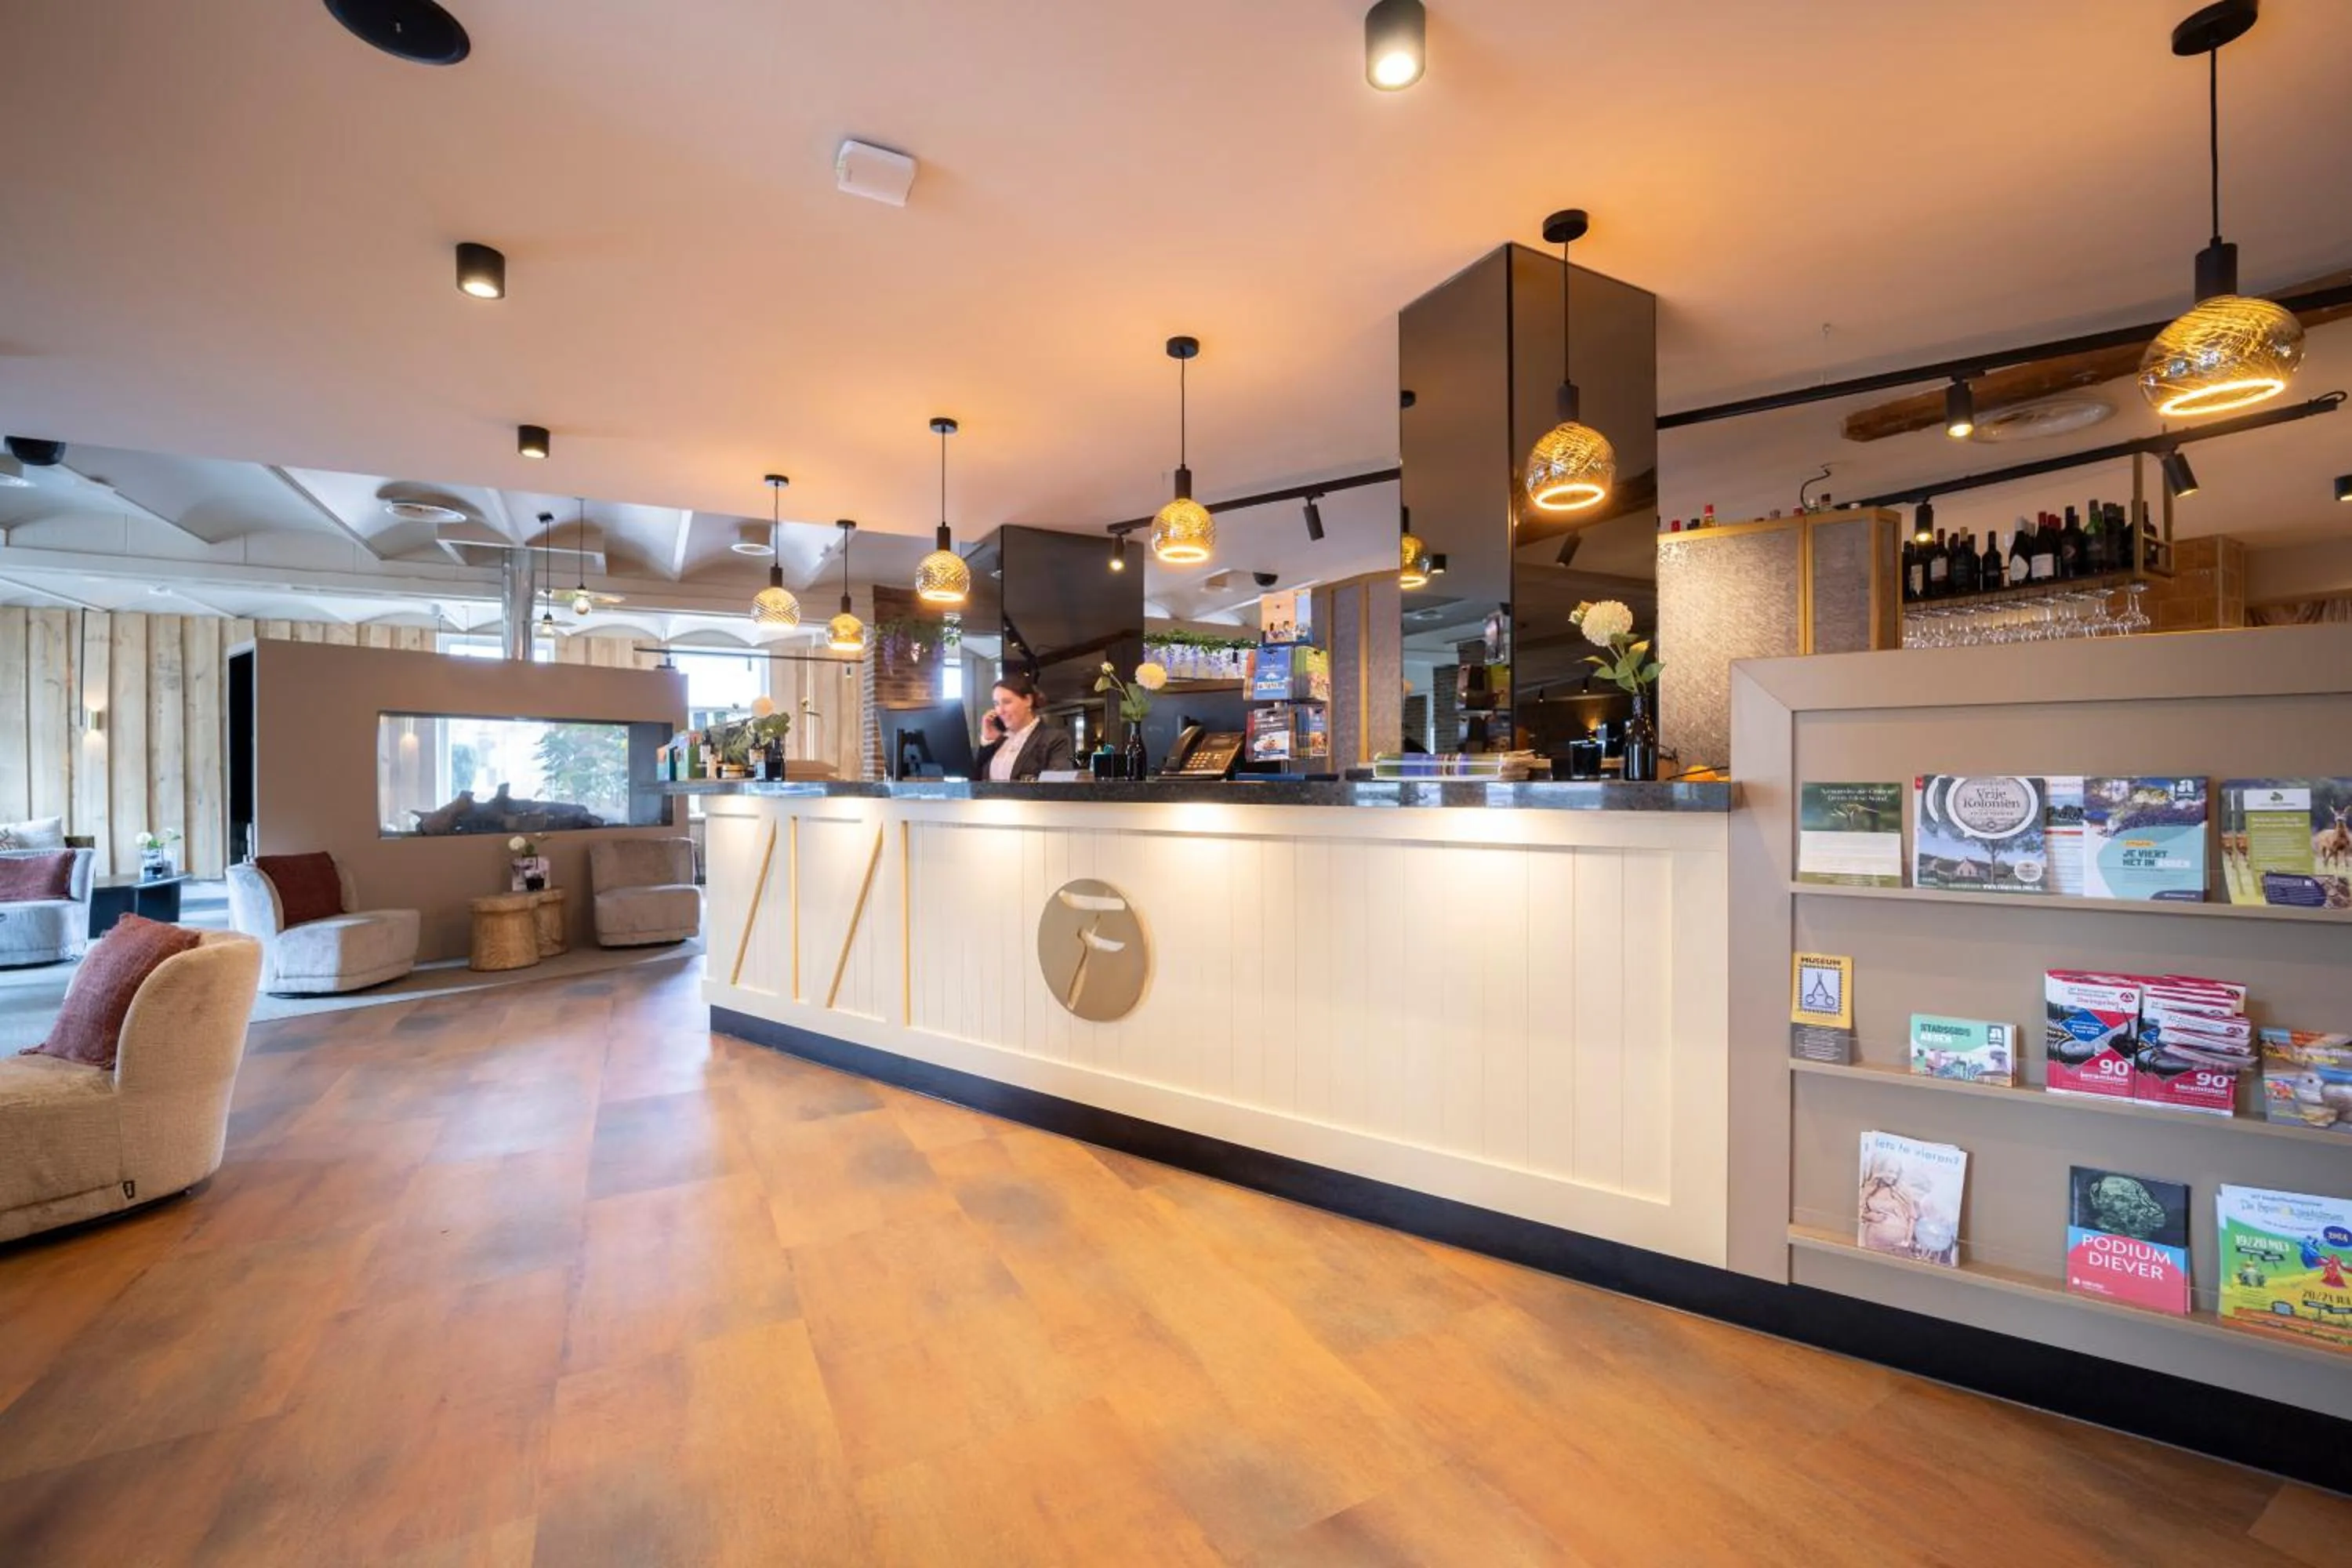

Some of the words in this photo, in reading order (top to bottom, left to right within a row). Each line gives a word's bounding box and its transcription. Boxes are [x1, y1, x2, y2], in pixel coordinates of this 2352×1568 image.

[1976, 787, 2007, 800] Vrije
[2122, 849, 2136, 858] JE
[1801, 956, 1842, 967] MUSEUM
[2099, 1059, 2129, 1076] 90
[2196, 1072, 2228, 1088] 90
[2082, 1233, 2171, 1265] PODIUM
[2089, 1251, 2163, 1279] DIEVER
